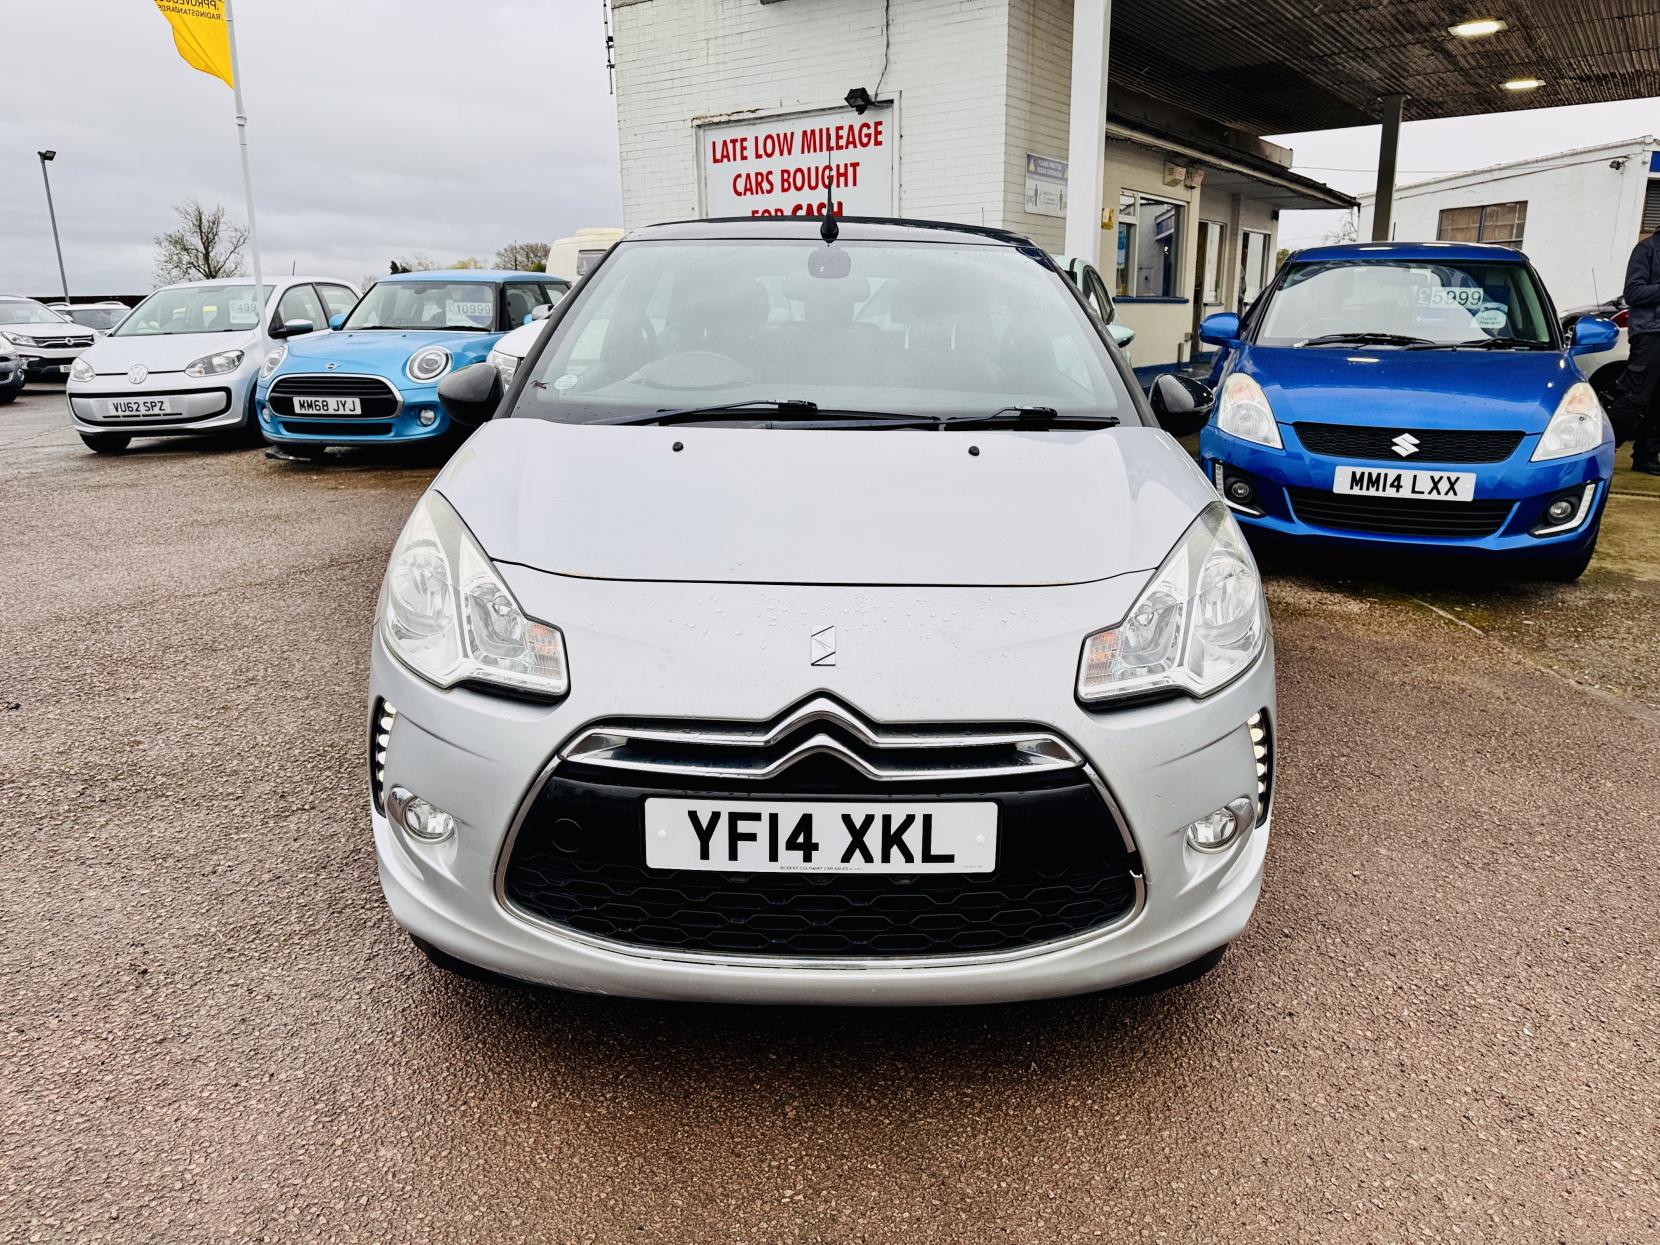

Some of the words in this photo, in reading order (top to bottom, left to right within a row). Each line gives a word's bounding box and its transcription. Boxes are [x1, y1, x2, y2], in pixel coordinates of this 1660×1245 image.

[712, 137, 748, 163] LATE
[754, 132, 795, 159] LOW
[801, 121, 883, 154] MILEAGE
[733, 171, 774, 196] CARS
[781, 162, 860, 193] BOUGHT
[112, 402, 141, 413] VU62
[143, 401, 166, 412] SPZ
[299, 399, 329, 412] MM68
[333, 399, 356, 412] JYJ
[1349, 470, 1403, 493] MM14
[1411, 474, 1461, 497] LXX
[687, 810, 820, 863] YF14
[840, 813, 955, 864] XKL
